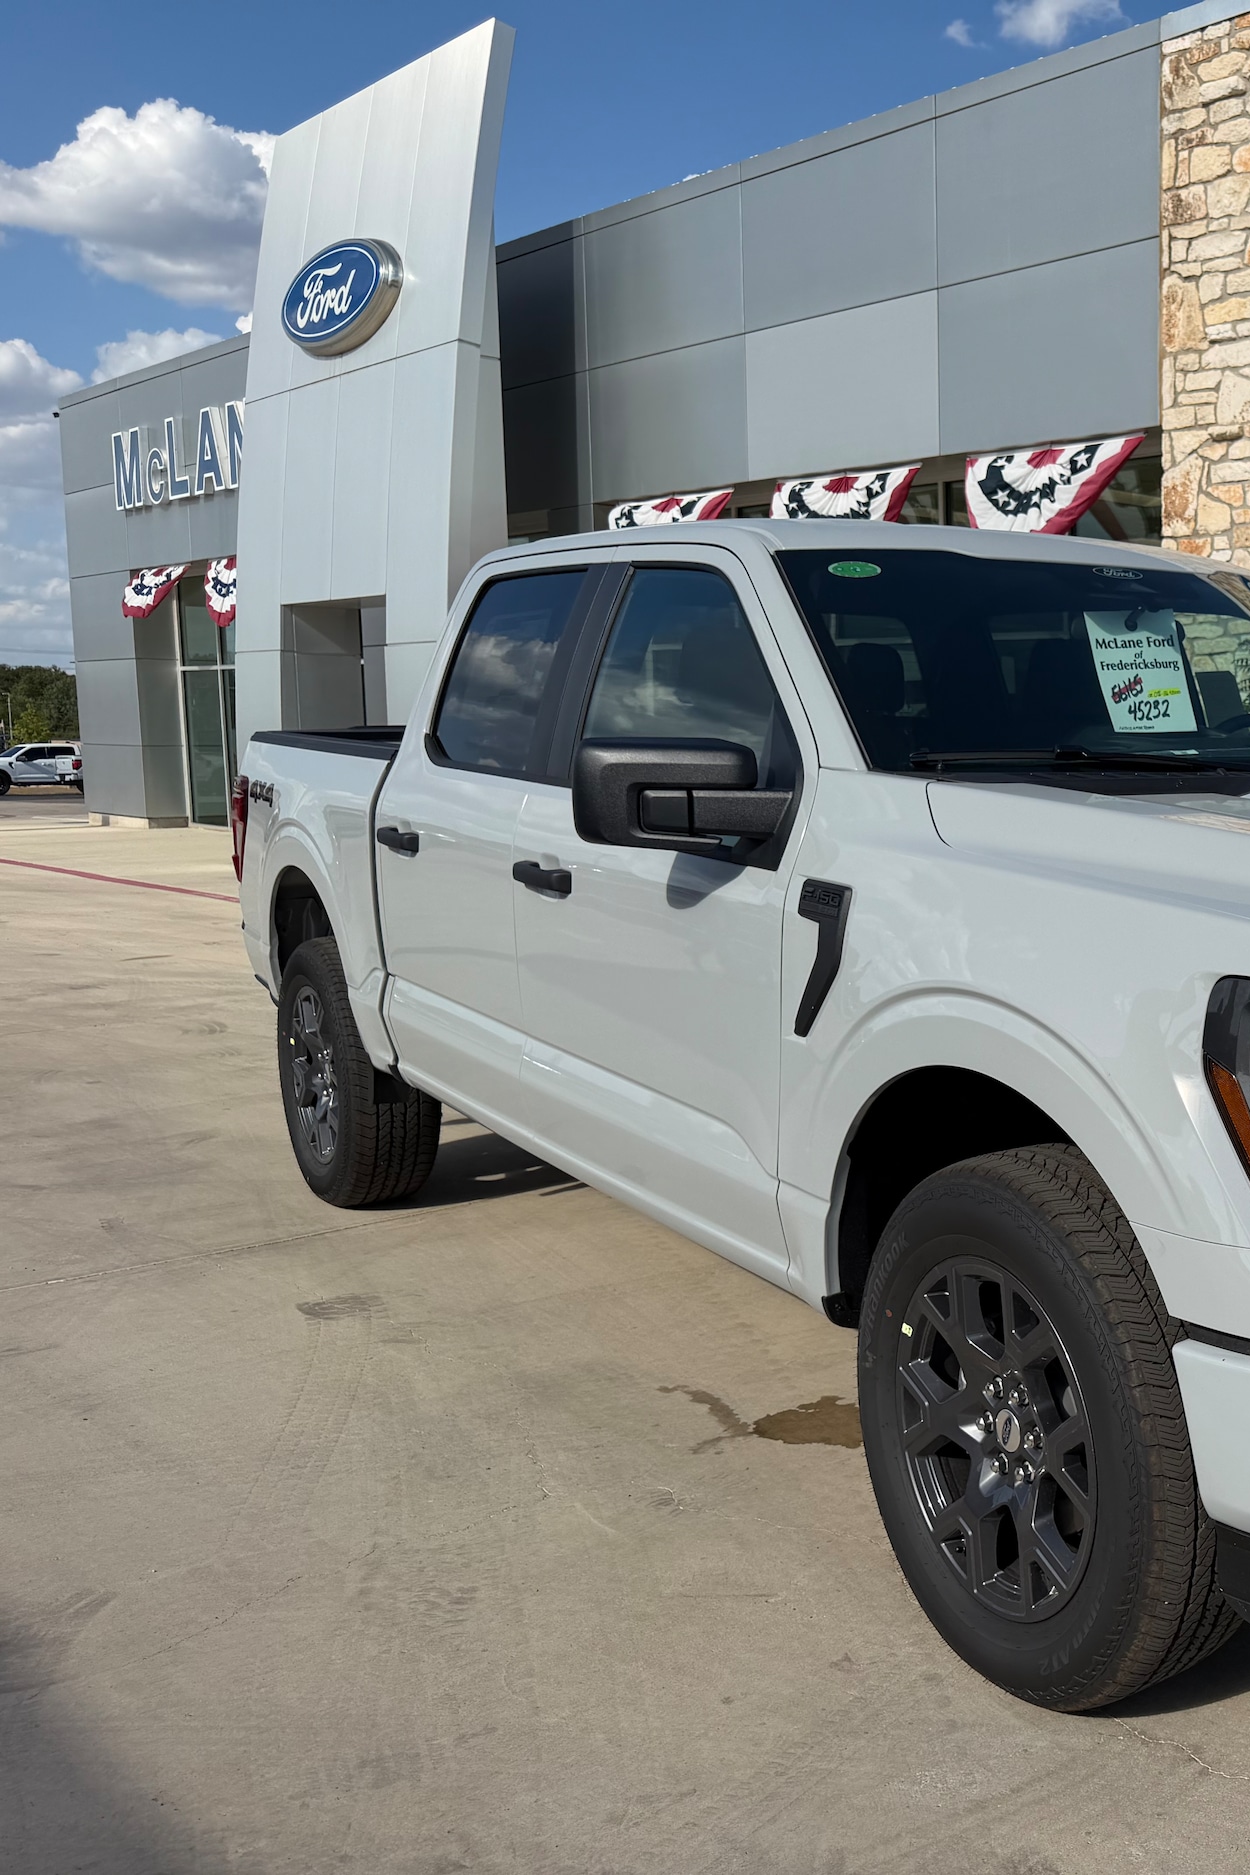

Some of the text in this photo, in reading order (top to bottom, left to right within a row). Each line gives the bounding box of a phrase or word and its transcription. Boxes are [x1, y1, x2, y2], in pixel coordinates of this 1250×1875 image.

[297, 263, 356, 329] Ford
[1095, 634, 1175, 650] McLane Ford
[1134, 650, 1143, 659] of
[1100, 659, 1180, 672] Fredericksburg
[1128, 699, 1171, 722] 45232
